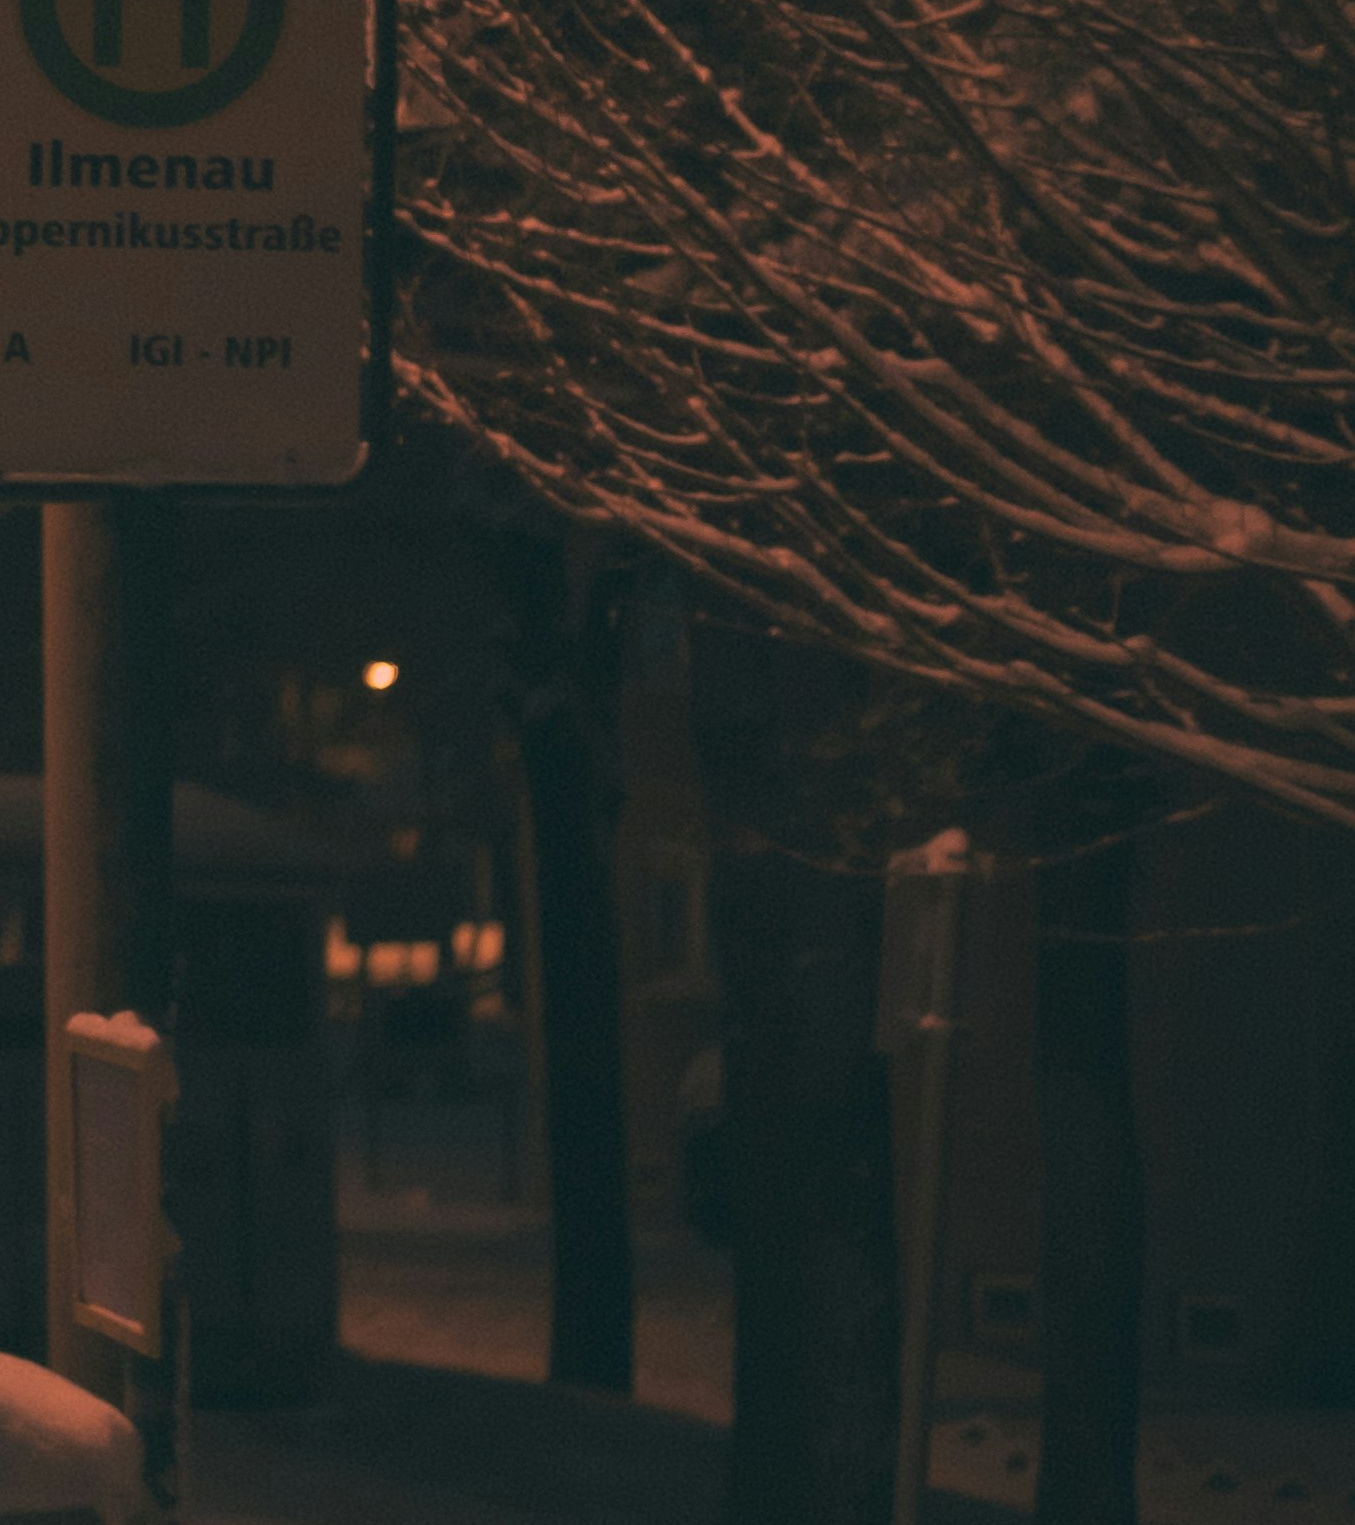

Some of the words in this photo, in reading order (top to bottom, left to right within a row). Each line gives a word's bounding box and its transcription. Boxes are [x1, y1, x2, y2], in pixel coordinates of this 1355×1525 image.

[28, 139, 275, 192] Ilmenau
[3, 331, 32, 364] A
[130, 334, 184, 367] IGI
[225, 336, 293, 368] NPI
